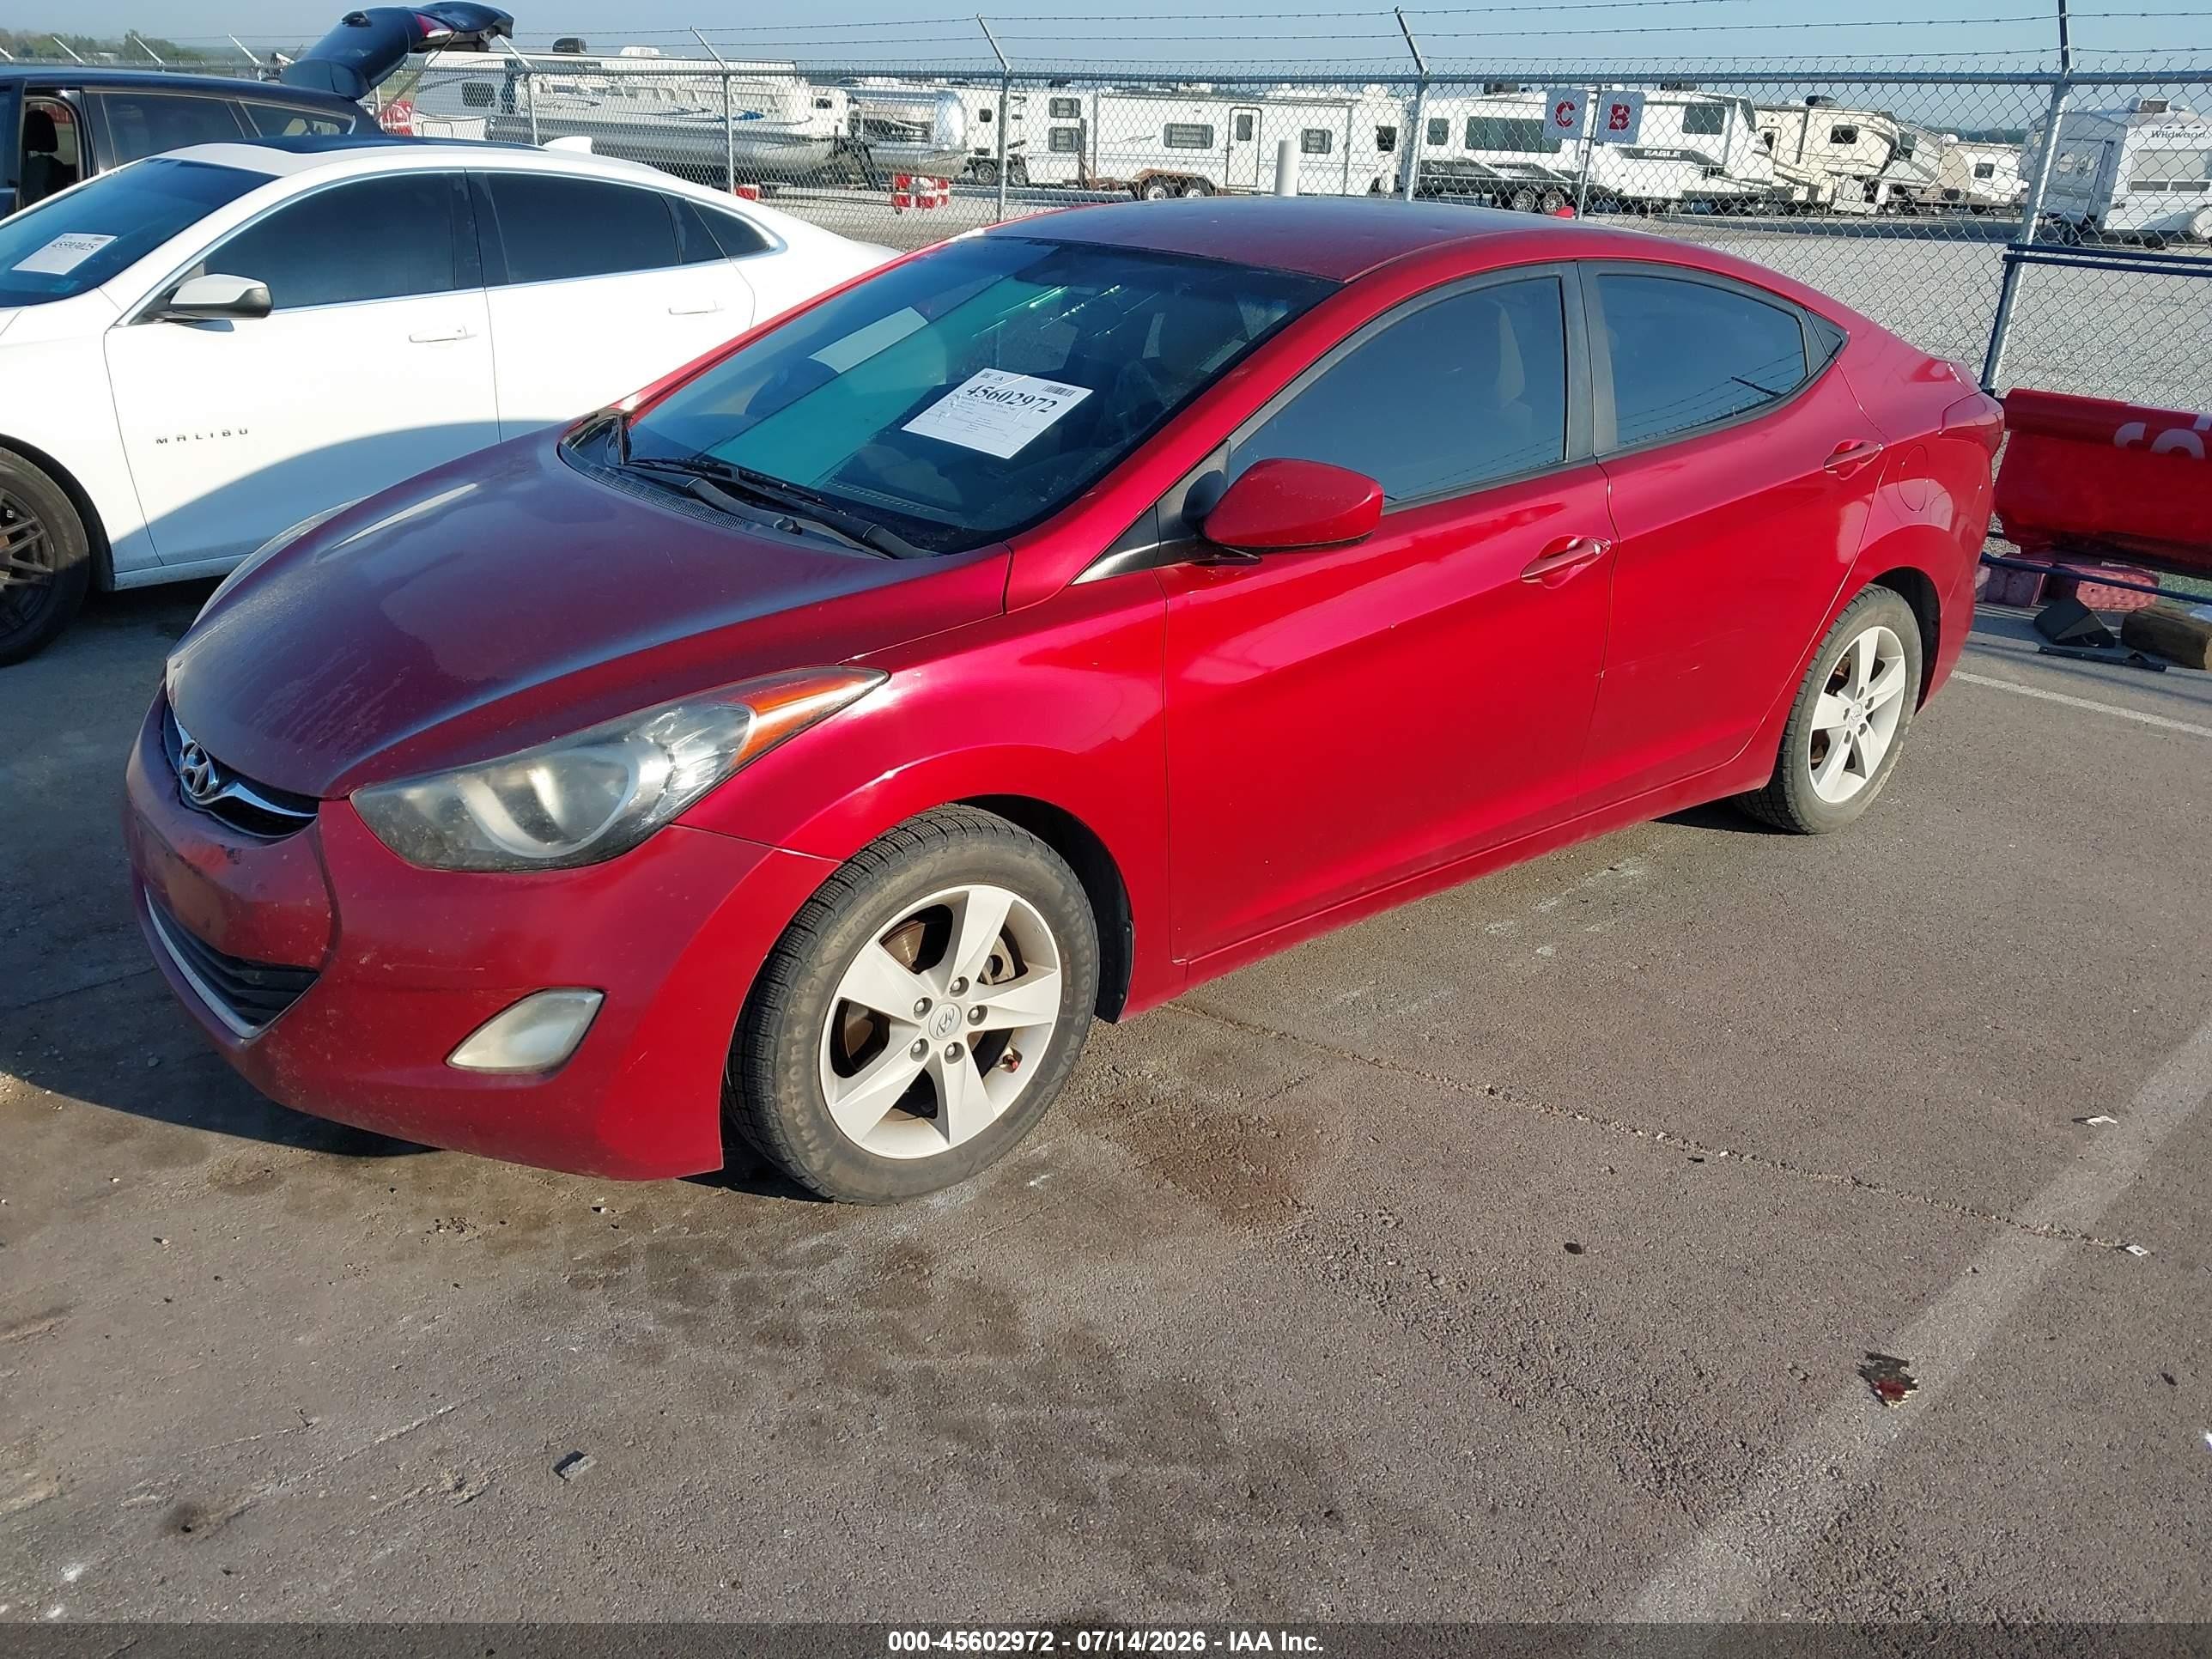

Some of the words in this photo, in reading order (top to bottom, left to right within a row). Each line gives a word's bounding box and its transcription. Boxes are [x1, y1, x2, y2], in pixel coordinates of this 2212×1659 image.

[1555, 101, 1576, 128] C
[1609, 103, 1631, 130] B
[1644, 149, 1681, 158] EAGLE
[966, 385, 1058, 413] 45602972
[155, 428, 248, 444] MALIBU
